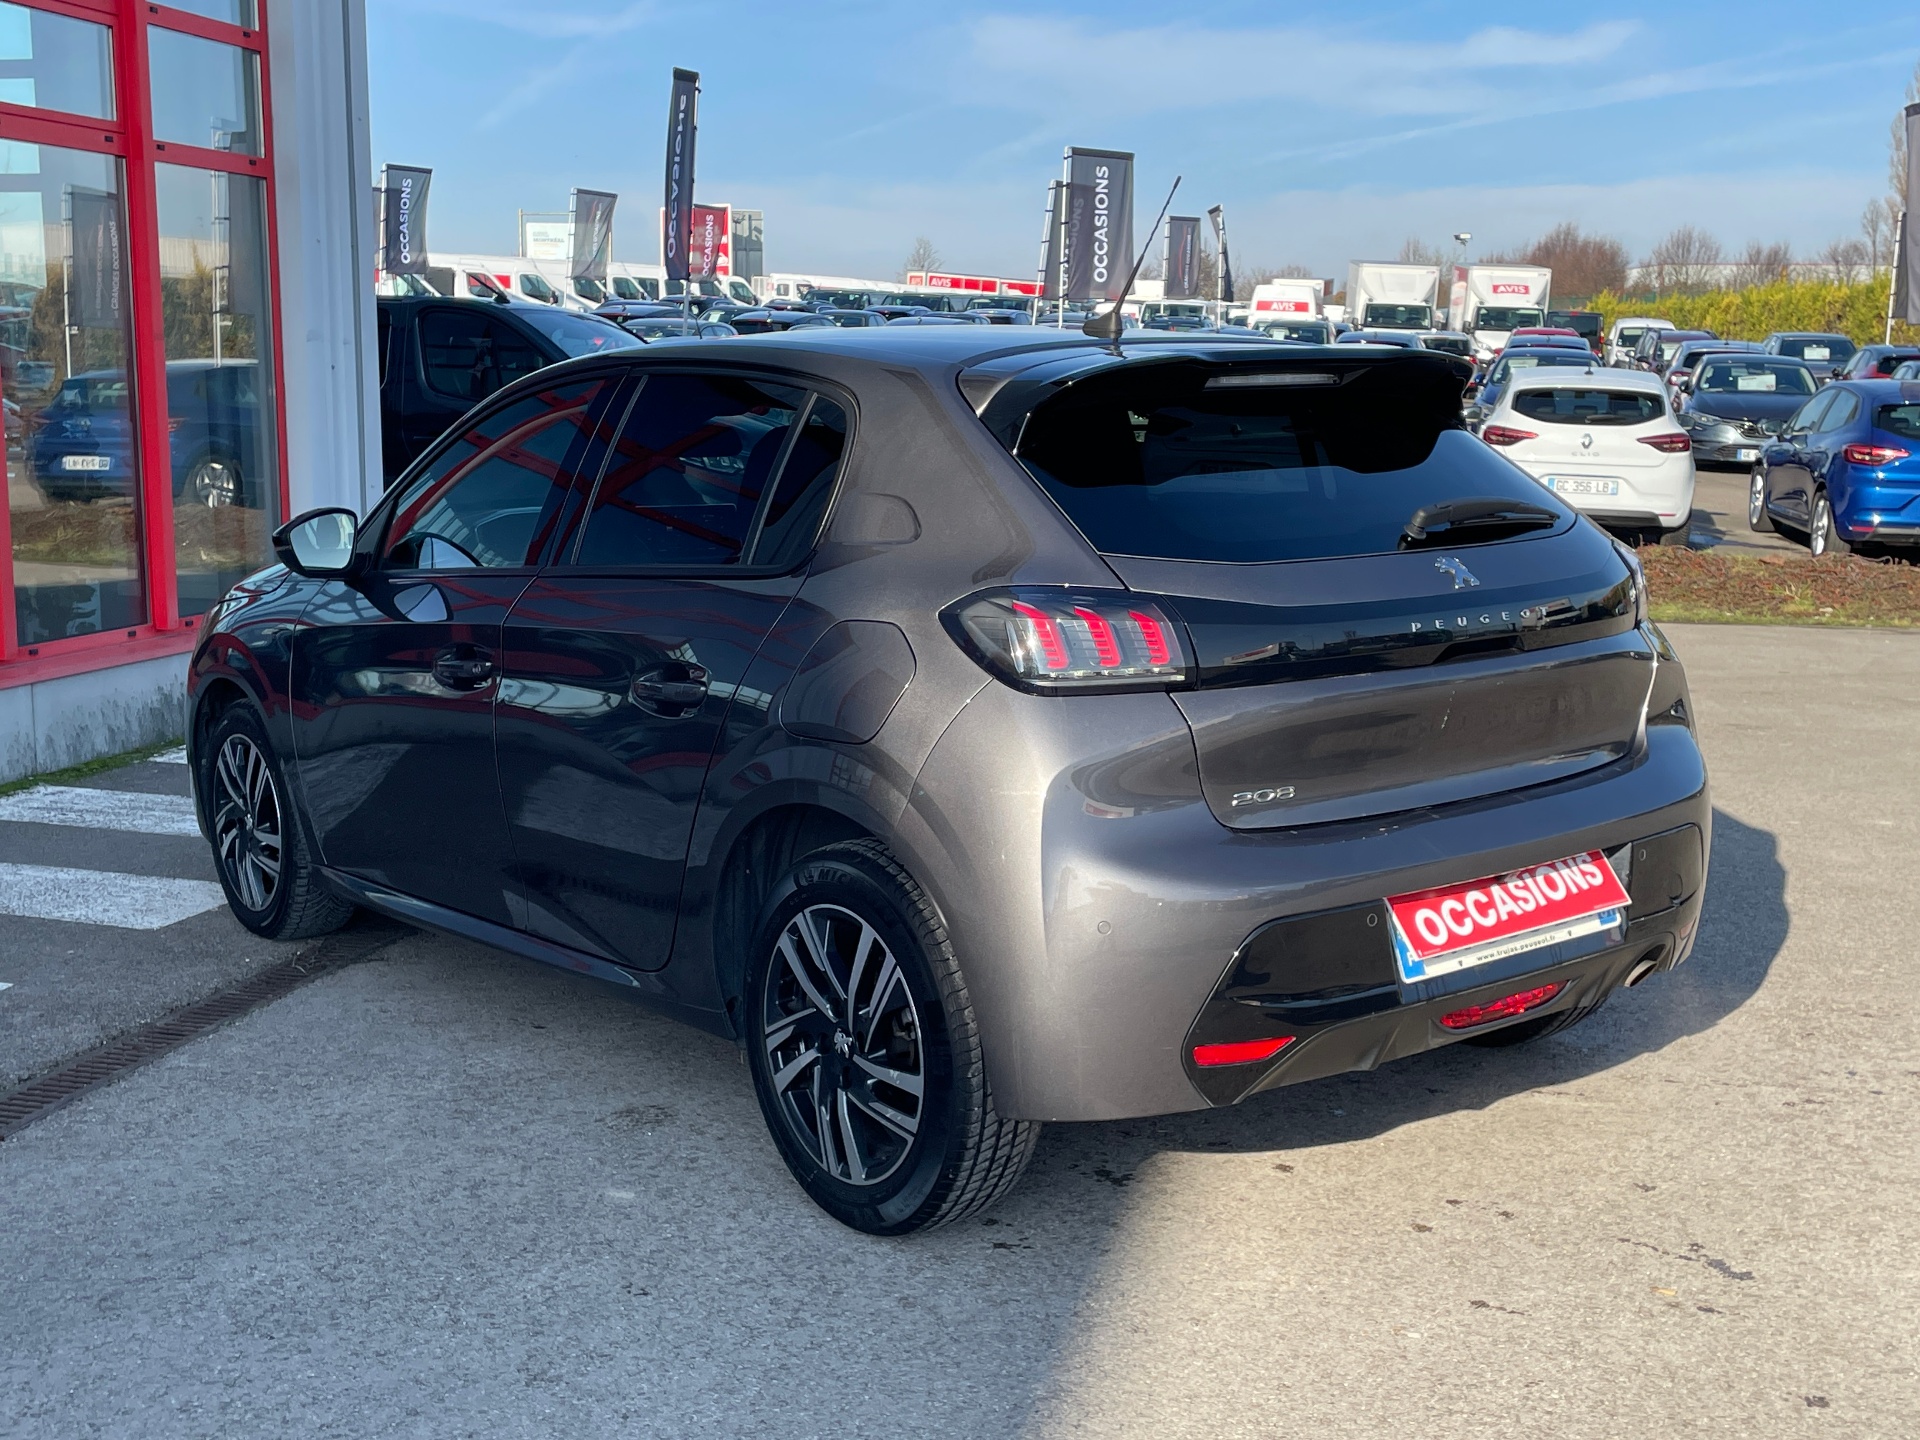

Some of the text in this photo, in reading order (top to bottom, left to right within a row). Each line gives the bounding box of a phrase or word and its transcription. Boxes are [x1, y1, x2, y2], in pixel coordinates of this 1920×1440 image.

[667, 94, 686, 259] OCCASIONS
[109, 221, 120, 270] OCCASIONS
[400, 178, 412, 264] OCCASIONS
[701, 214, 714, 277] OCCASIONS
[1093, 165, 1110, 283] OCCASIONS
[930, 277, 952, 288] AVIS
[1270, 302, 1296, 312] AVIS
[1497, 285, 1526, 294] AVIS
[1410, 606, 1549, 633] PEUGEOT
[1231, 785, 1296, 807] 208
[1414, 854, 1604, 946] OCCASIONS
